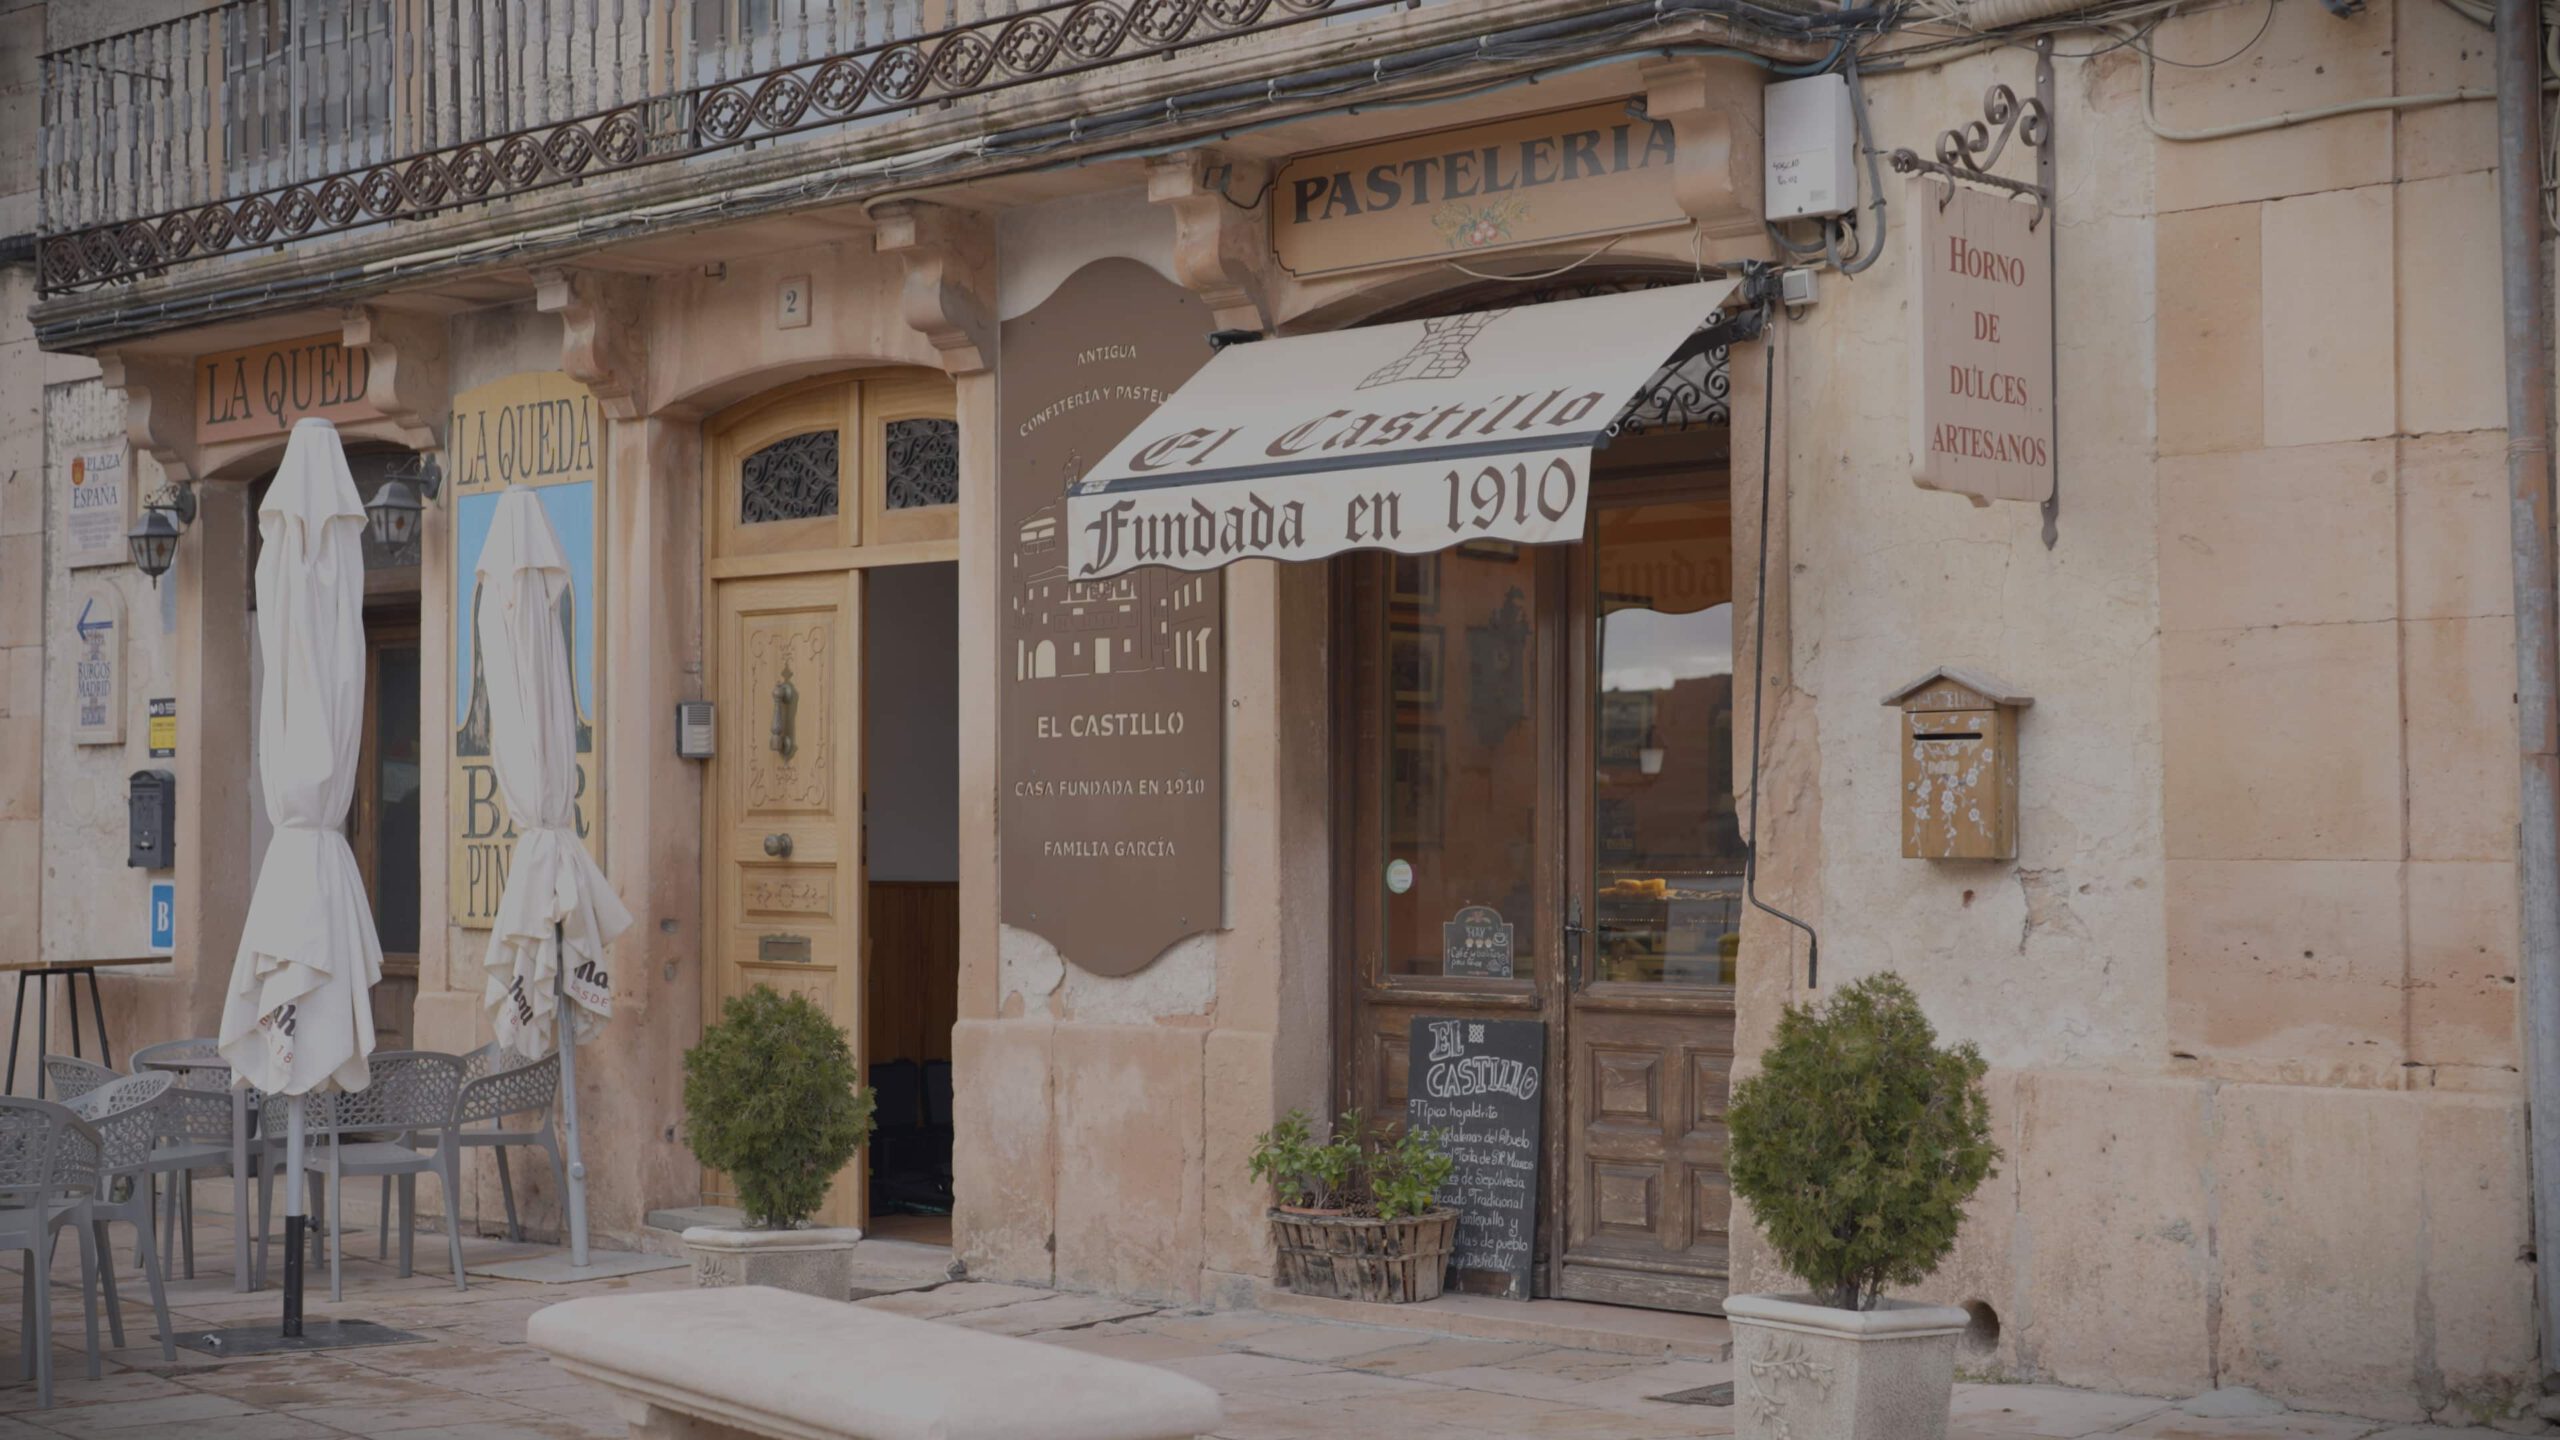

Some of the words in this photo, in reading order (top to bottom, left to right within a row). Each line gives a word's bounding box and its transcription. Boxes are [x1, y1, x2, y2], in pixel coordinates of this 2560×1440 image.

[1292, 118, 1676, 224] PASTELERIA
[1949, 236, 2025, 287] HORNO
[786, 289, 797, 313] 2
[1974, 312, 2000, 343] DE
[1077, 345, 1137, 366] ANTIGUA
[206, 357, 253, 424] LA
[263, 342, 371, 429] QUED
[1950, 364, 2027, 407] DULCES
[1020, 387, 1100, 437] CONFITERIA
[1103, 386, 1111, 401] Y
[457, 410, 490, 486] LA
[498, 395, 594, 485] QUEDA
[1129, 426, 1245, 471] El
[1264, 386, 1606, 458] Castillo
[1931, 423, 2047, 467] ARTESANOS
[87, 454, 120, 471] PLAZA
[73, 483, 118, 508] ESPAÑA
[1078, 490, 1306, 577] Fundada
[1344, 490, 1402, 544] en
[1443, 456, 1577, 533] 1910
[79, 679, 111, 697] MADRID
[1038, 716, 1062, 738] EL
[1070, 711, 1184, 737] CASTILLO
[462, 763, 590, 840] BR
[1015, 782, 1055, 796] CASA
[1059, 779, 1133, 796] FUNDADA
[1139, 779, 1158, 795] EN
[1166, 778, 1204, 795] 1910
[1044, 841, 1109, 857] FAMILIA
[1114, 836, 1176, 857] GARCÍA
[157, 901, 169, 932] B
[1427, 1056, 1539, 1100] CASTILLO
[1479, 1149, 1491, 1165] de
[1461, 1167, 1473, 1184] de
[1475, 1168, 1525, 1189] Sepúlveda
[1468, 1188, 1524, 1210] Tradicional
[1480, 1231, 1493, 1248] de
[1496, 1236, 1528, 1254] pueblo
[1508, 1218, 1518, 1238] y
